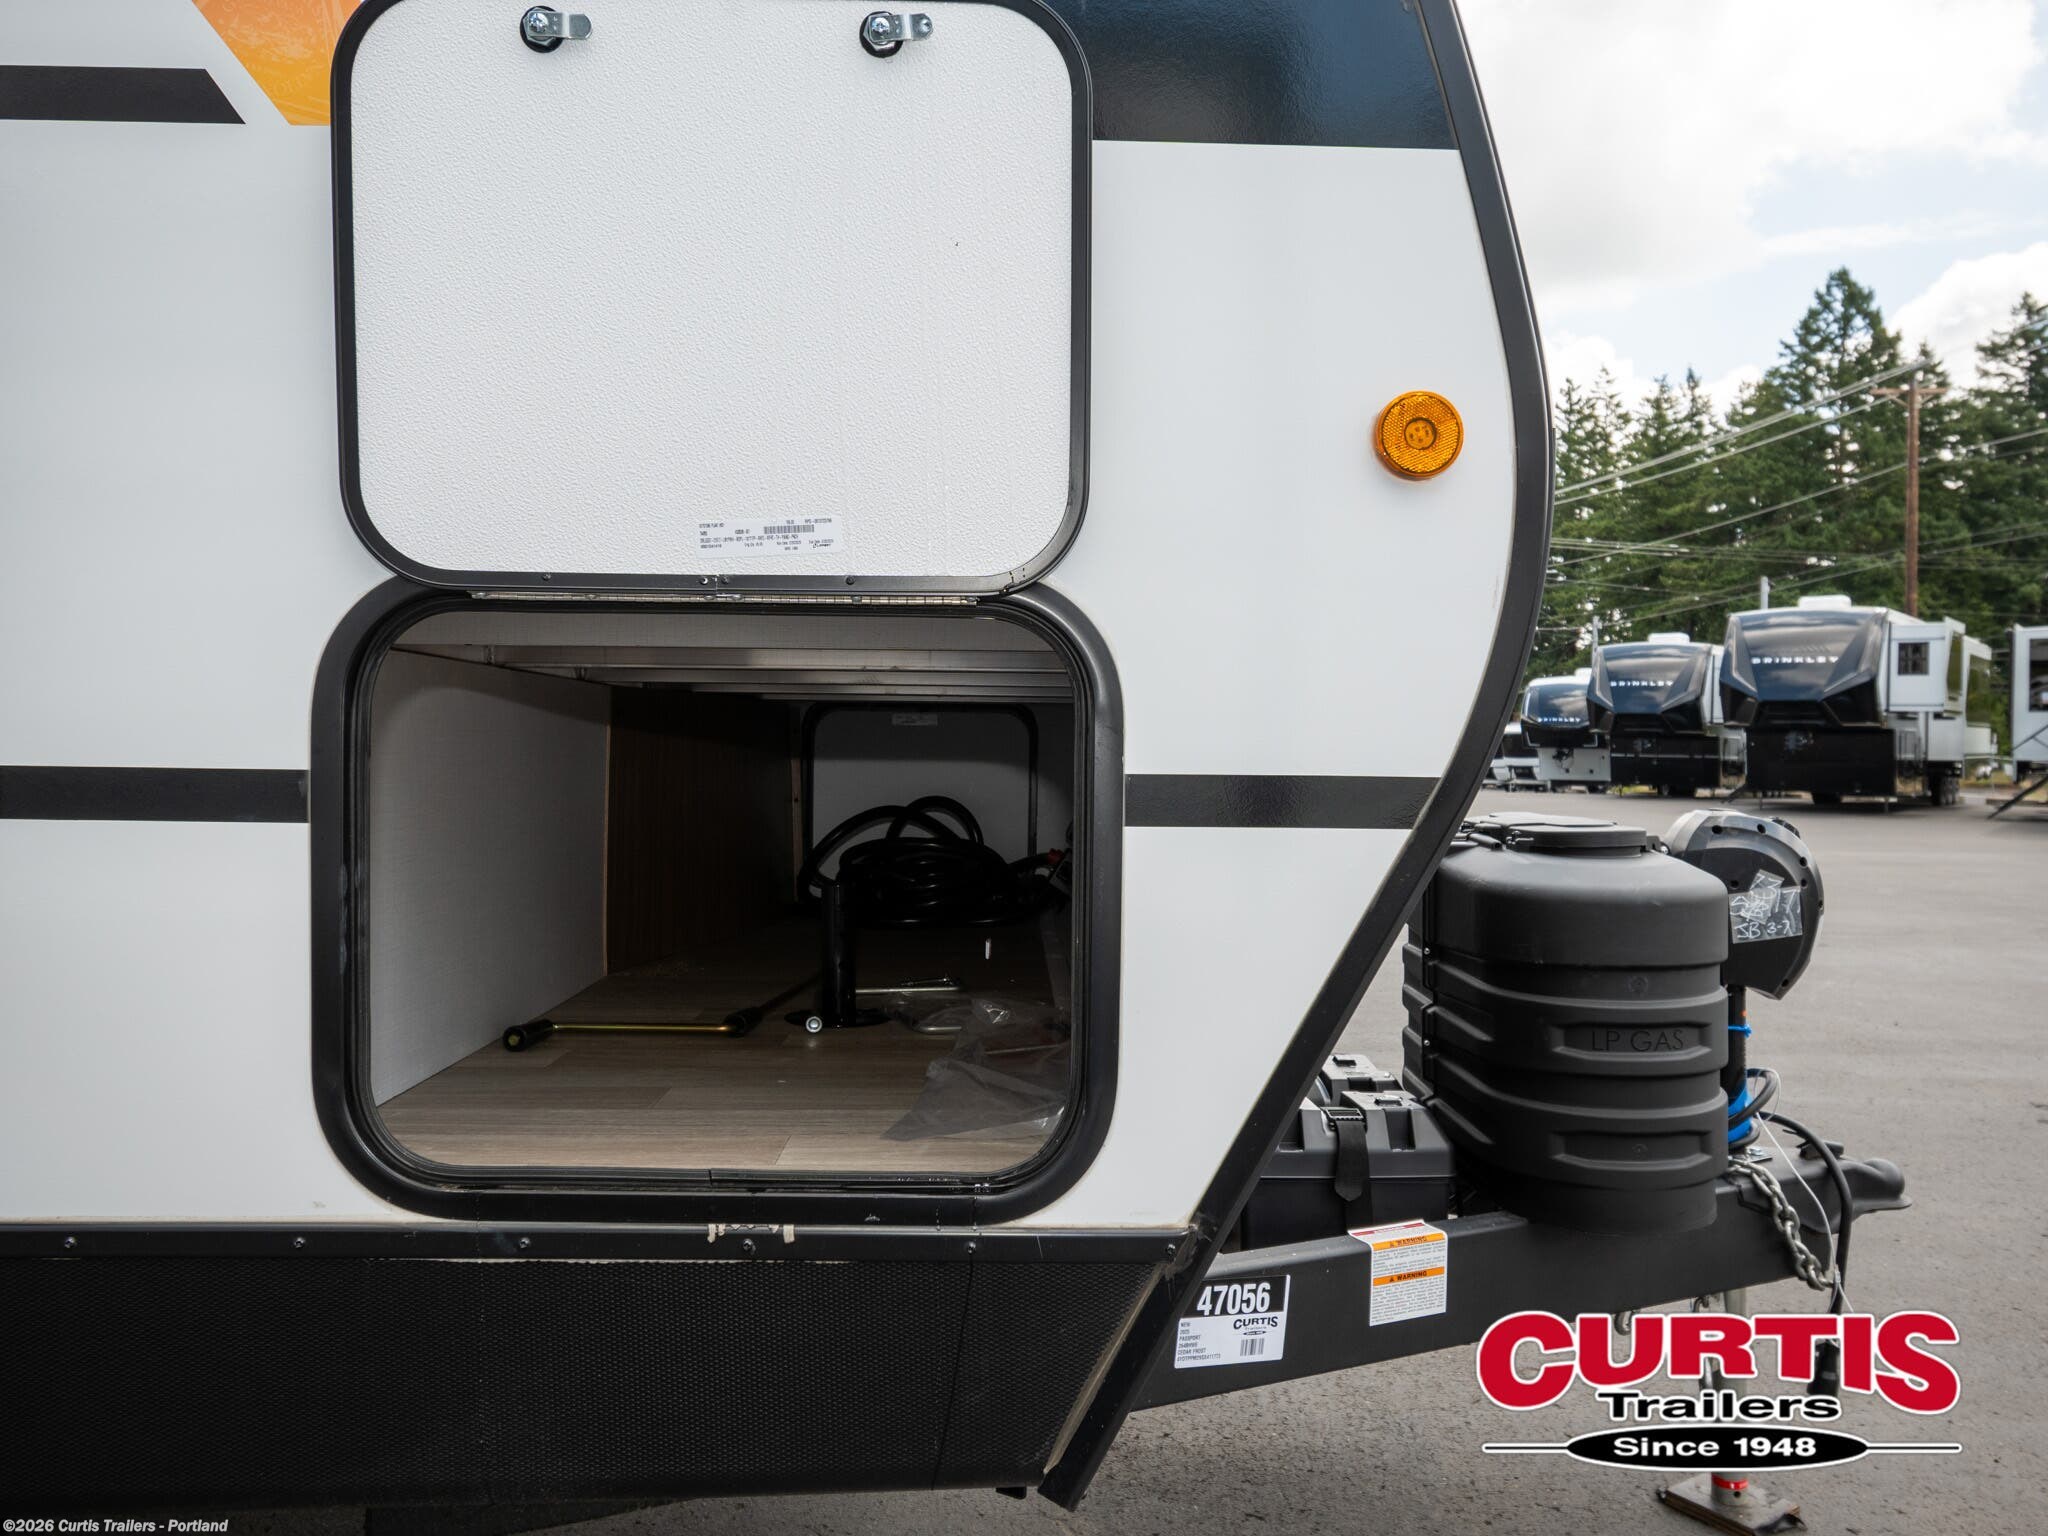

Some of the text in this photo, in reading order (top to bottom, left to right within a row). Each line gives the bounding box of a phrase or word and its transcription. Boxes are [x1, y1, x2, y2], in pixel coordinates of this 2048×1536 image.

[1751, 656, 1840, 664] BRINKLEY
[1591, 1029, 1683, 1052] LP GAS
[1397, 1270, 1428, 1281] WARNING
[1196, 1281, 1271, 1316] 47056
[1233, 1316, 1278, 1330] CURTIS
